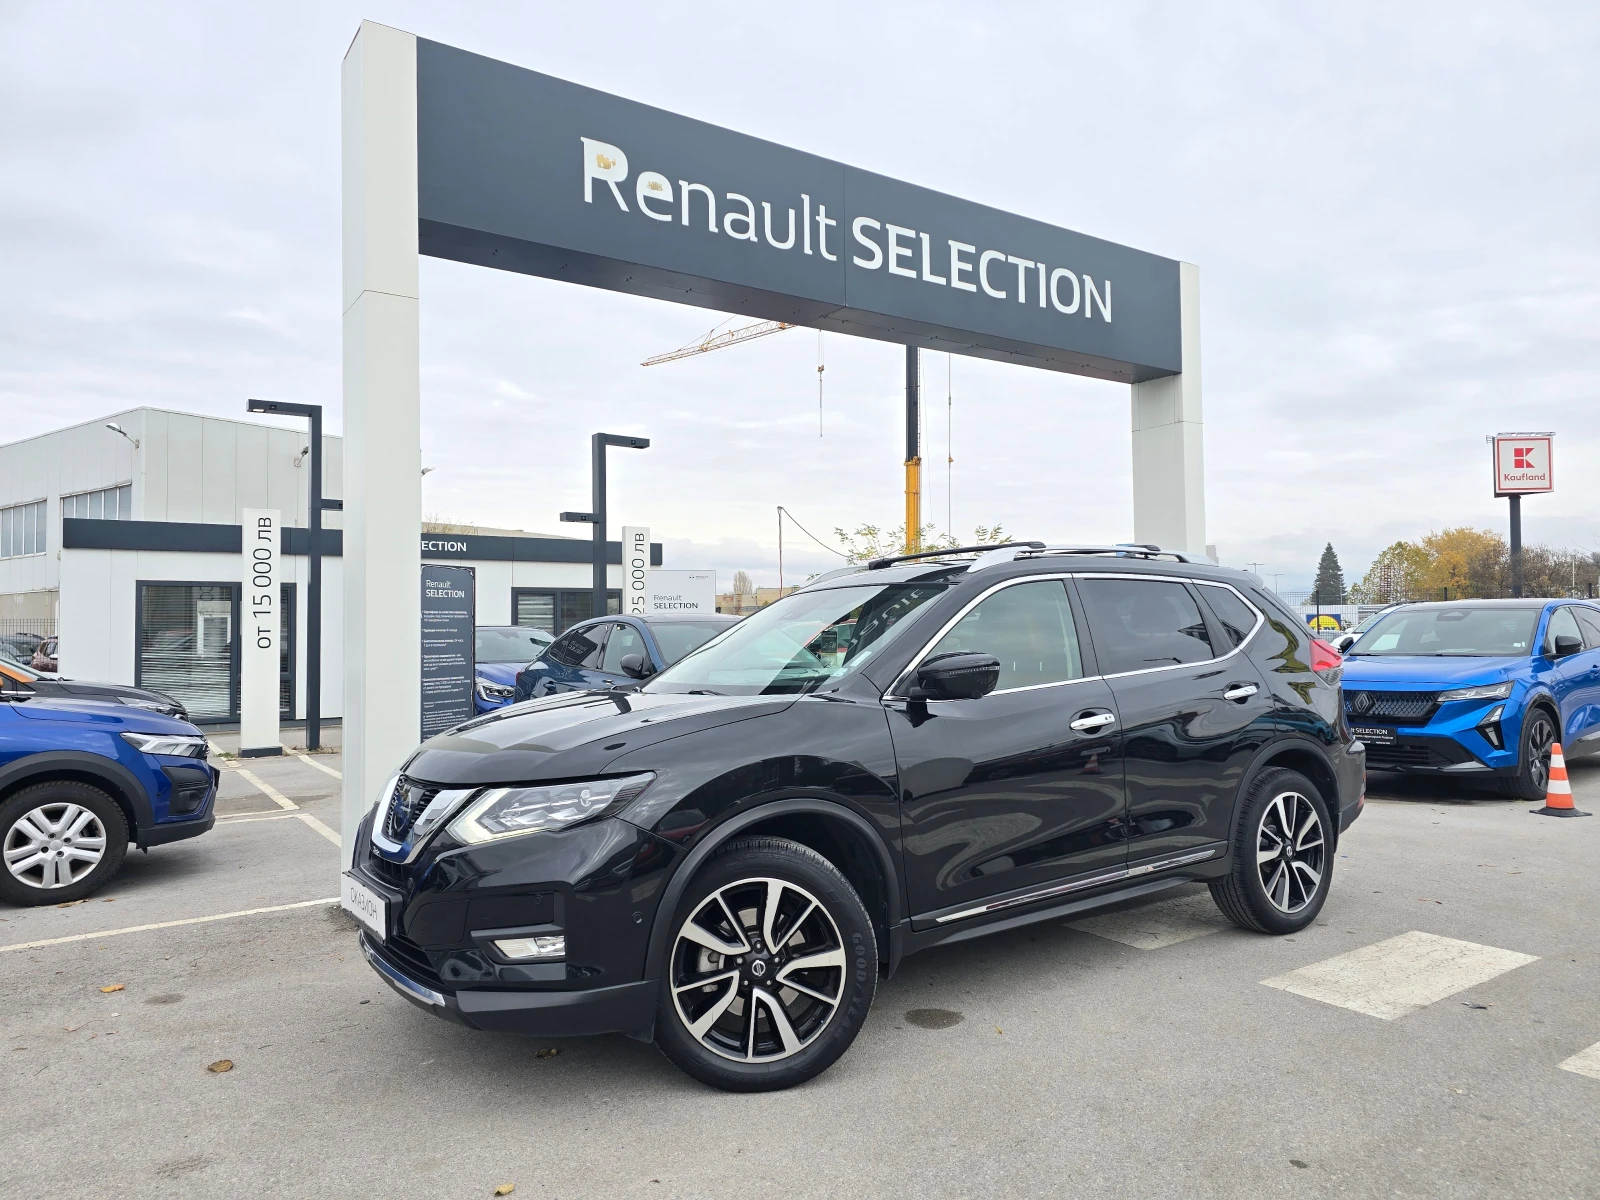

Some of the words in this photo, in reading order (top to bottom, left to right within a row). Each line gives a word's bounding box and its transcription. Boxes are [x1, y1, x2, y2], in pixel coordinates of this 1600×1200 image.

[581, 137, 837, 261] Renault
[852, 217, 1112, 323] SELECTION
[1504, 473, 1546, 481] Kaufland
[252, 548, 272, 588] 000
[632, 558, 645, 591] 000
[425, 579, 452, 589] Renault
[425, 590, 465, 598] SELECTION
[252, 595, 272, 618] 15
[653, 602, 699, 610] SELECTION
